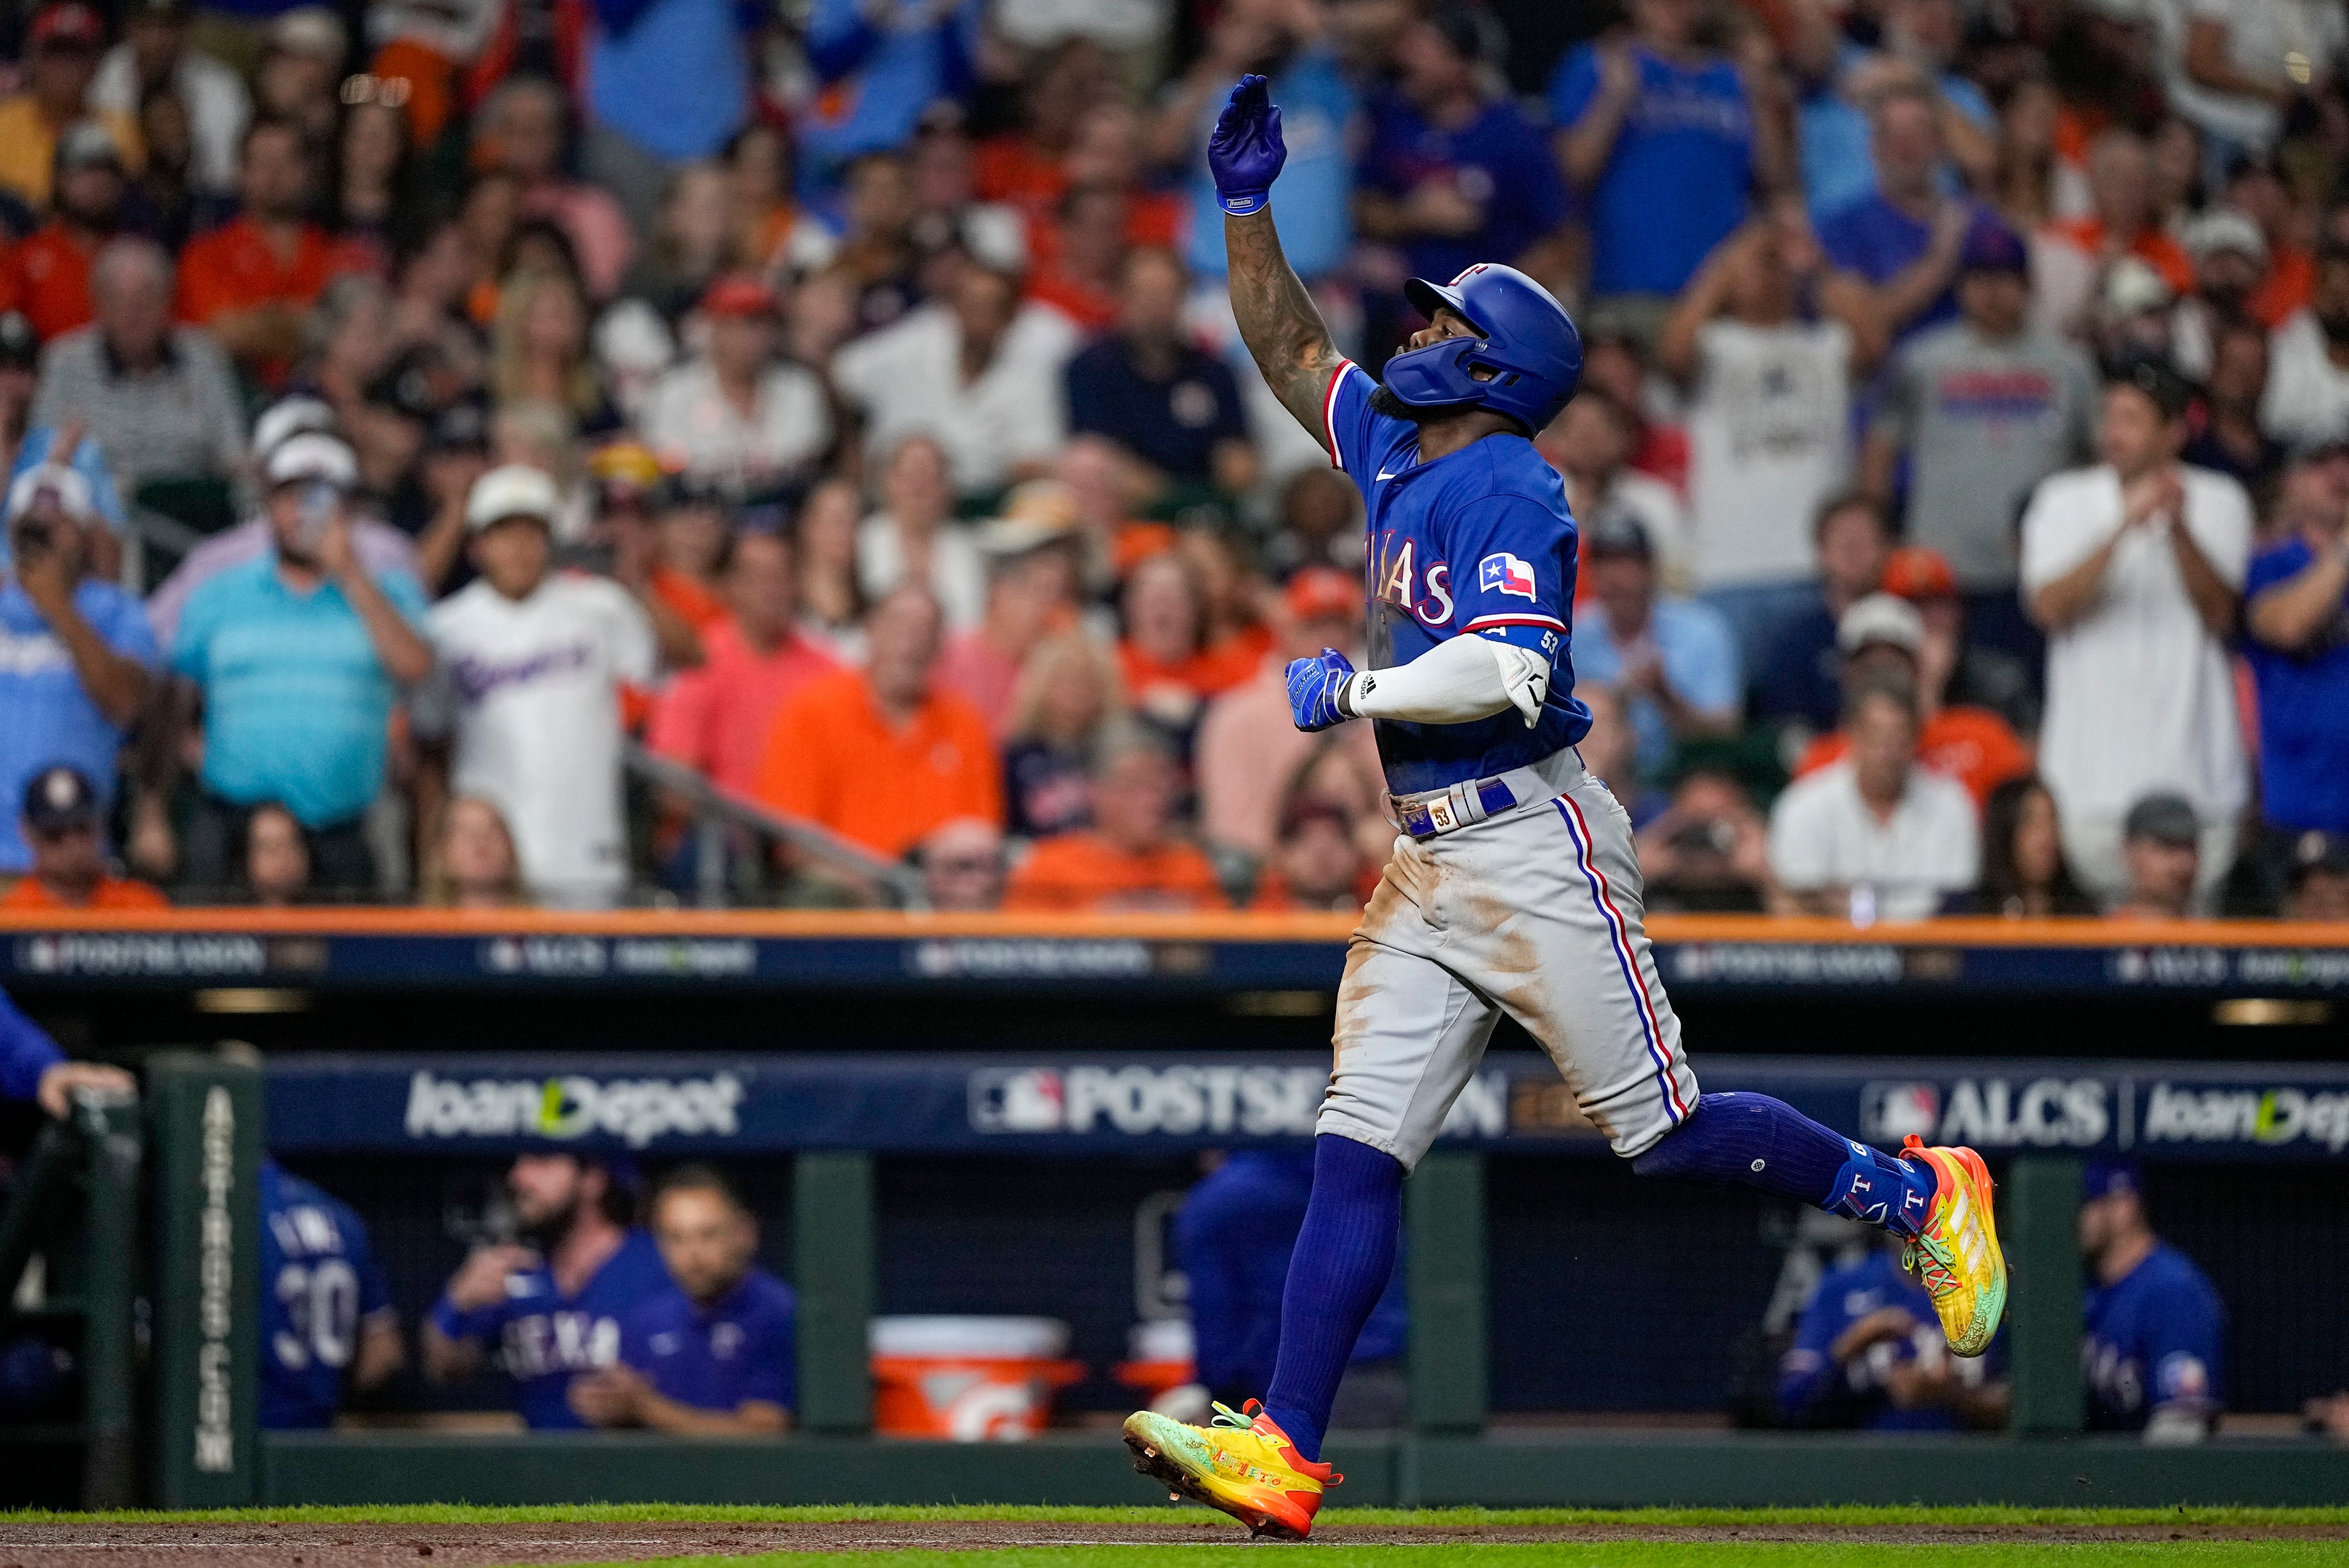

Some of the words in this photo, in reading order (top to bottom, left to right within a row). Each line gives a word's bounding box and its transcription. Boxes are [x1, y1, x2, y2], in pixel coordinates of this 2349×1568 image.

[1540, 630, 1558, 654] 53
[1360, 674, 1371, 700] adidas
[1435, 807, 1450, 827] 53
[405, 1070, 743, 1149] loanDepot
[1940, 1078, 2109, 1147] ALCS
[1851, 1173, 1872, 1194] T
[1905, 1188, 1924, 1209] T
